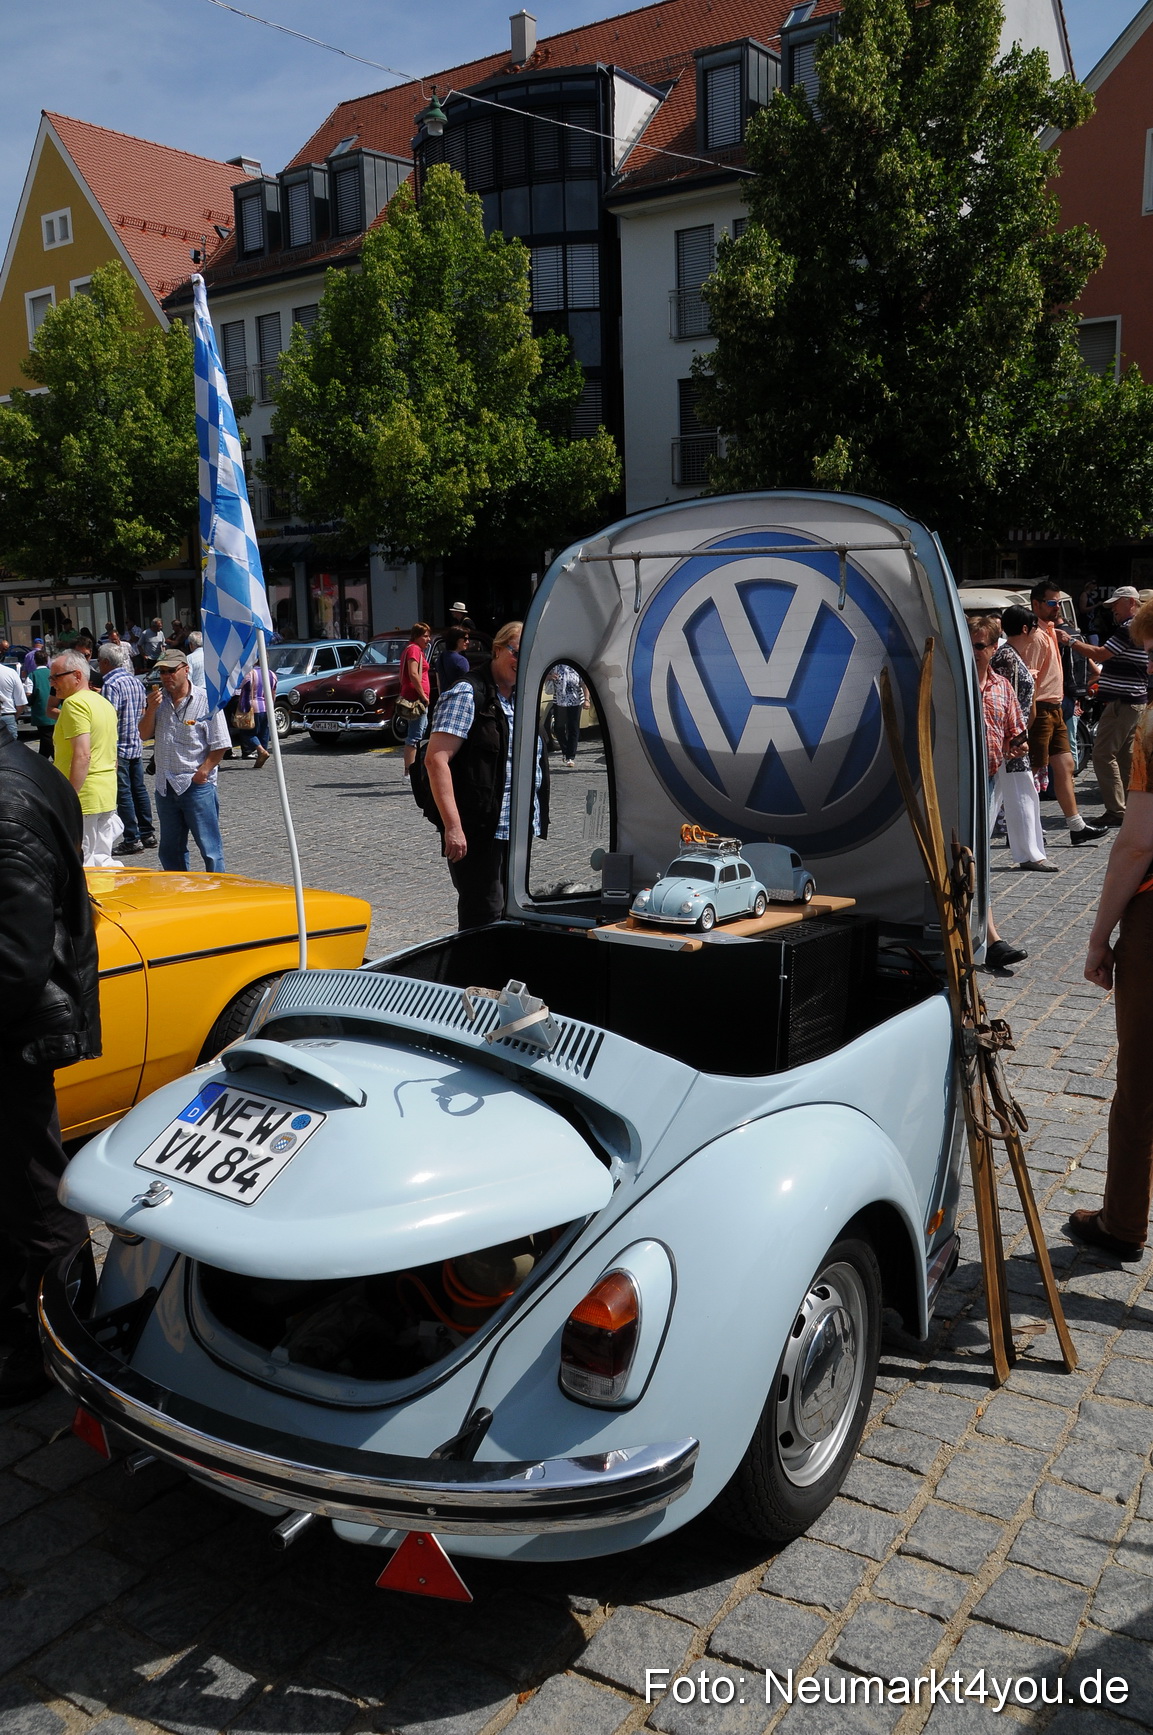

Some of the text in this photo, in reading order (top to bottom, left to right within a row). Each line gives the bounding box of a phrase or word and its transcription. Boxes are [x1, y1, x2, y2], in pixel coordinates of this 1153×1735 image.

[652, 558, 884, 832] VW
[187, 1107, 200, 1118] D
[196, 1093, 293, 1145] NEW
[155, 1127, 274, 1194] VW 84
